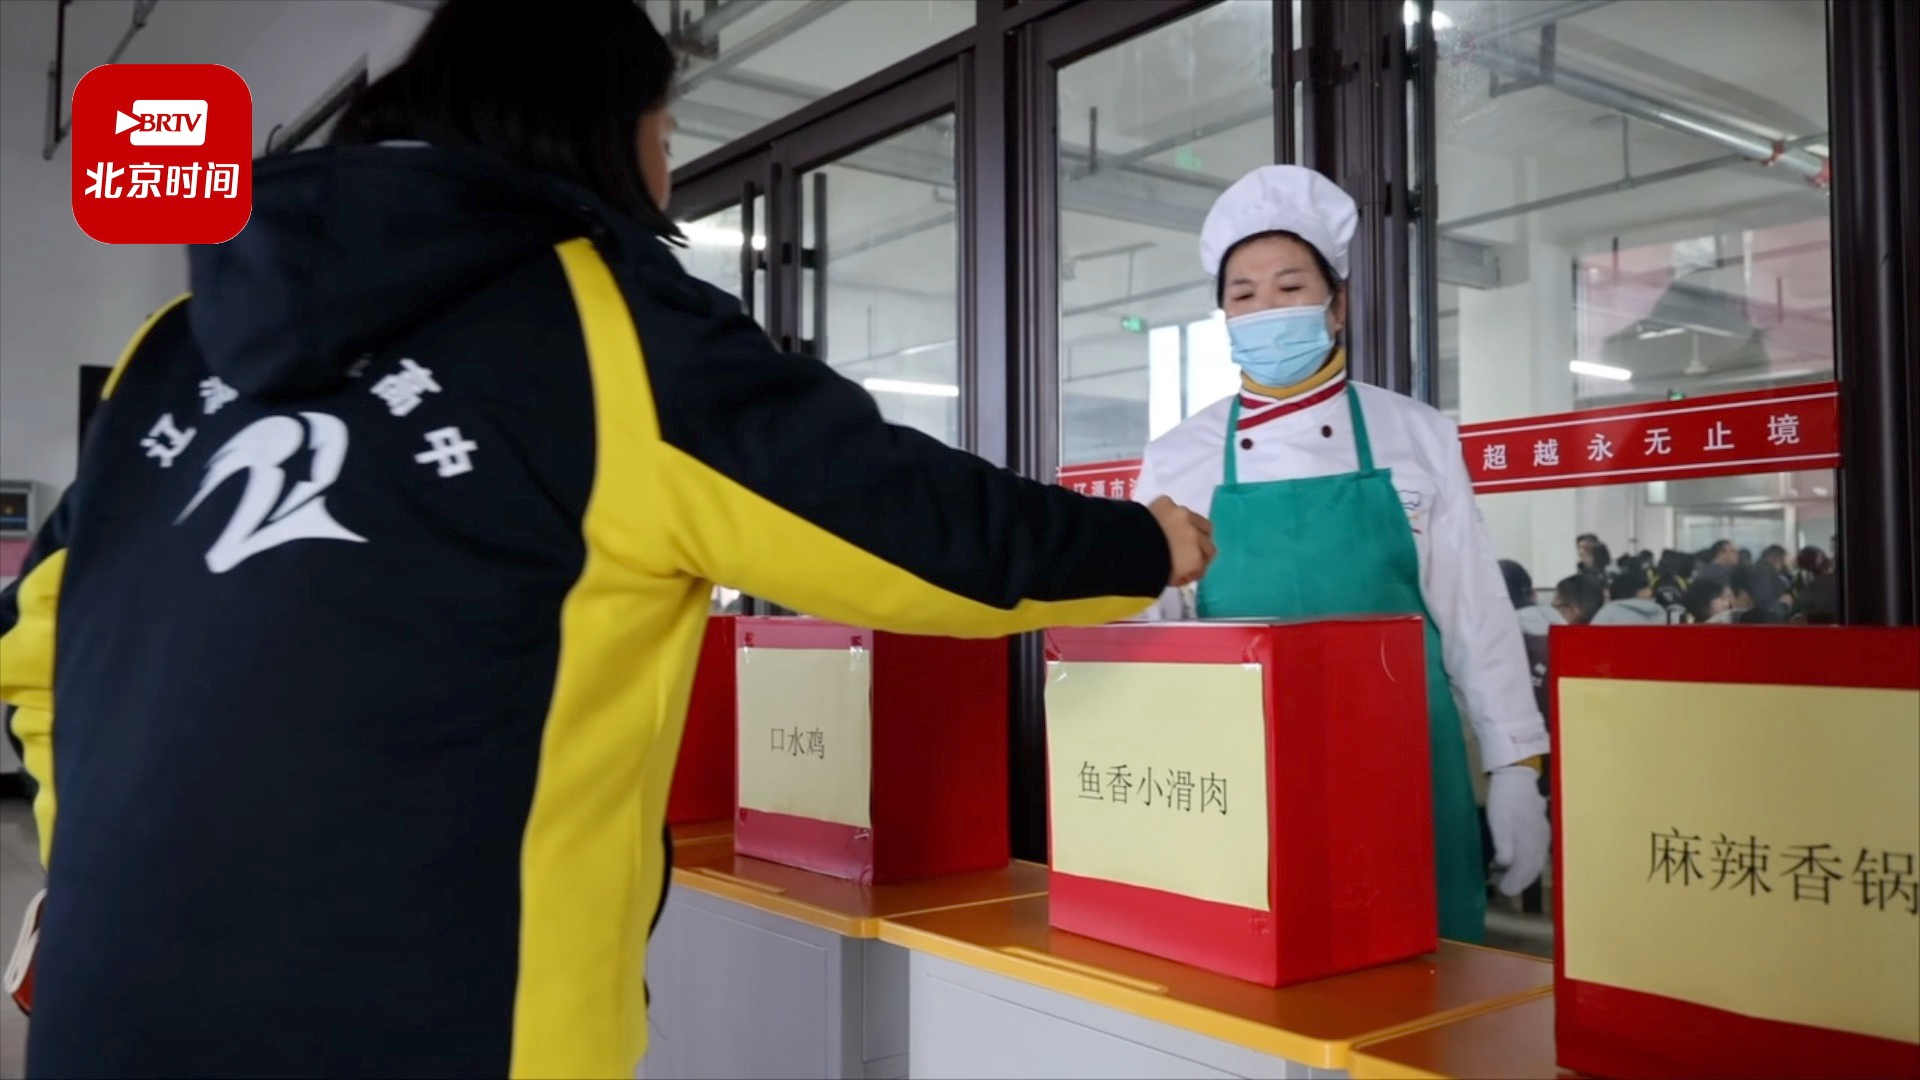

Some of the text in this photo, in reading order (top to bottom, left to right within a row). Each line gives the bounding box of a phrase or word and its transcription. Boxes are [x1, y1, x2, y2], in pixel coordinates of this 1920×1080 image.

[1482, 413, 1801, 472] 超越永无止境
[1073, 478, 1138, 501] 辽源市
[770, 726, 826, 760] 口水鸡
[1078, 759, 1228, 816] 鱼香小滑肉
[1647, 826, 1920, 916] 麻辣香锅
